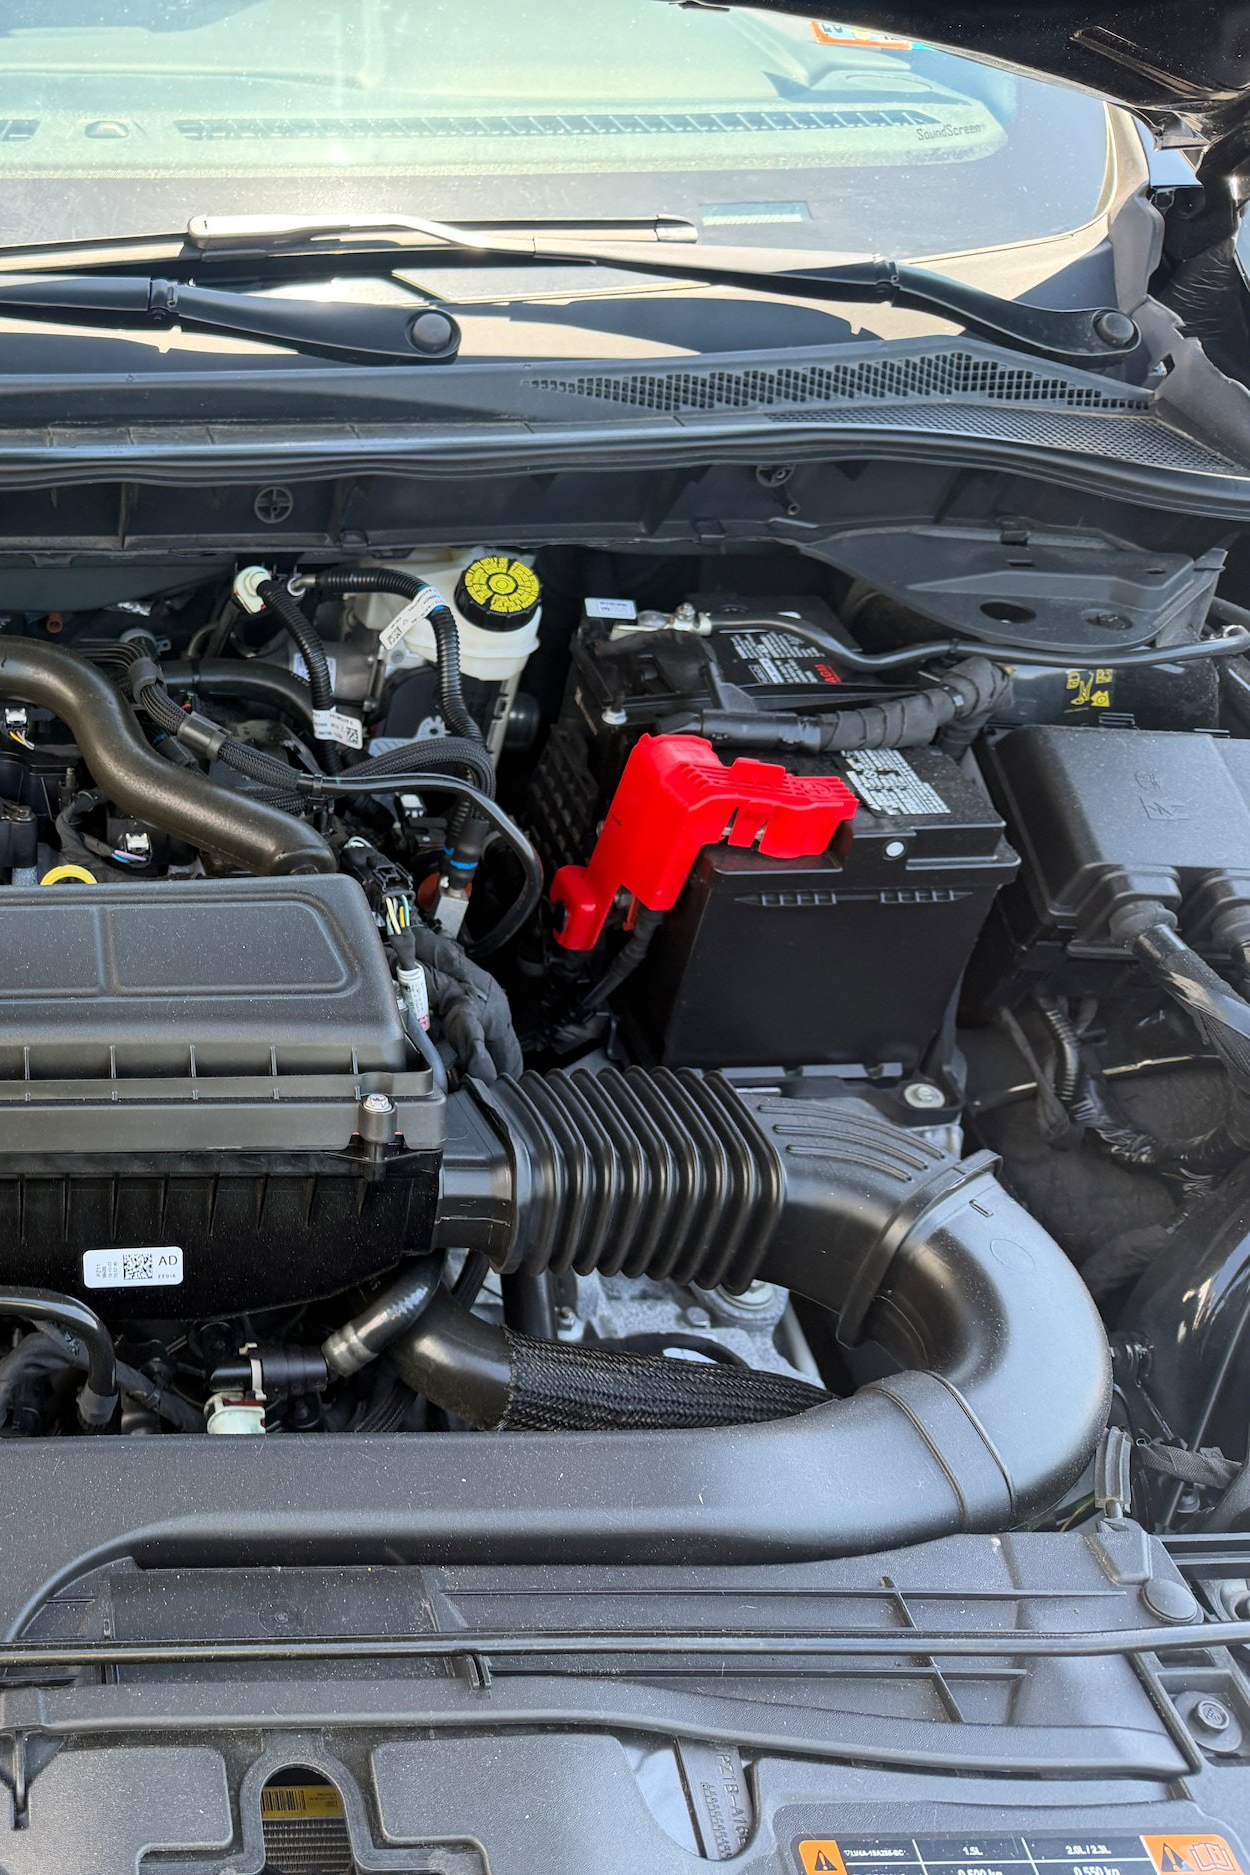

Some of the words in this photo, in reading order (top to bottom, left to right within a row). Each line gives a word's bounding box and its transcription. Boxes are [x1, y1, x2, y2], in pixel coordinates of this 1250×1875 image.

[916, 123, 981, 141] SoundScreen
[158, 1255, 178, 1266] AD
[962, 1846, 984, 1856] 1.5L
